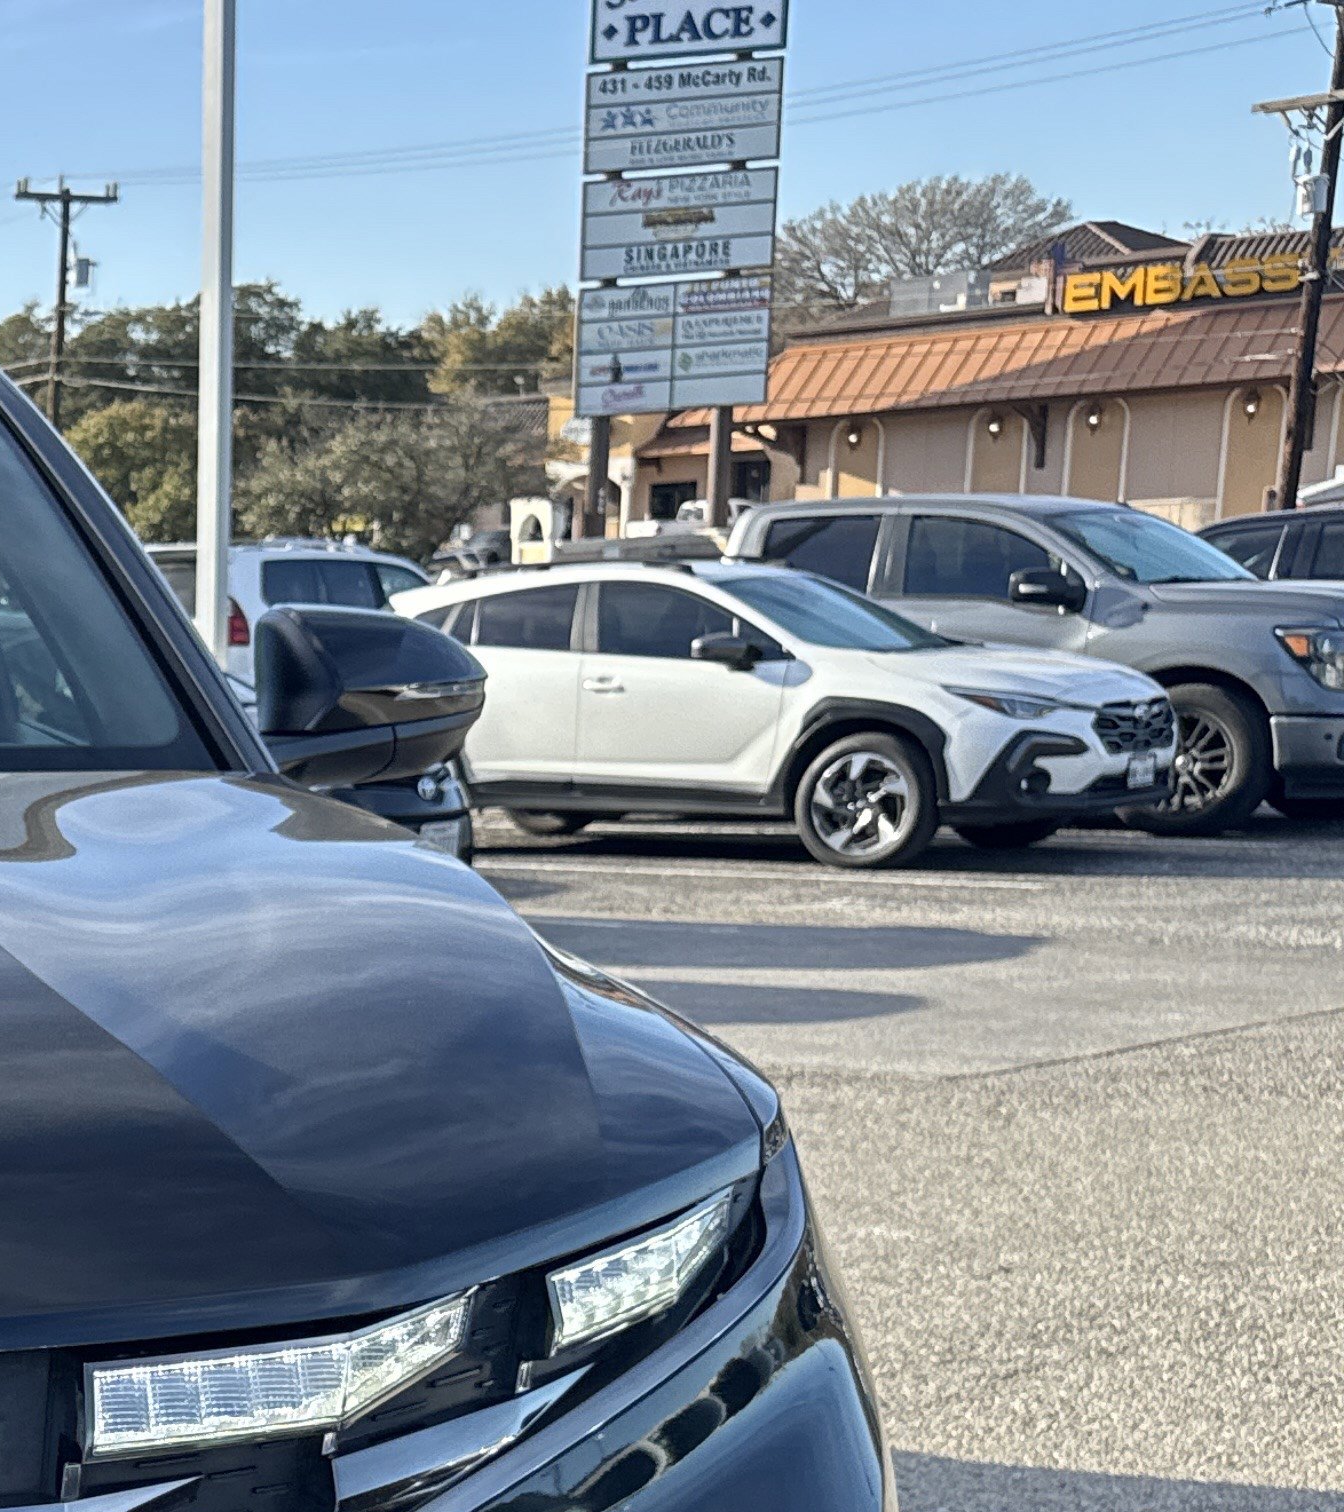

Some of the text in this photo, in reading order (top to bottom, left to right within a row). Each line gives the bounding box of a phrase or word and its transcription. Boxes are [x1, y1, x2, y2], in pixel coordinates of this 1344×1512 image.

[623, 6, 755, 47] PLACE
[599, 78, 627, 95] 431
[643, 73, 673, 91] 459
[678, 69, 743, 89] McCarty
[747, 66, 772, 83] Rd.
[665, 99, 770, 120] Community
[623, 240, 731, 265] SINGAPORE
